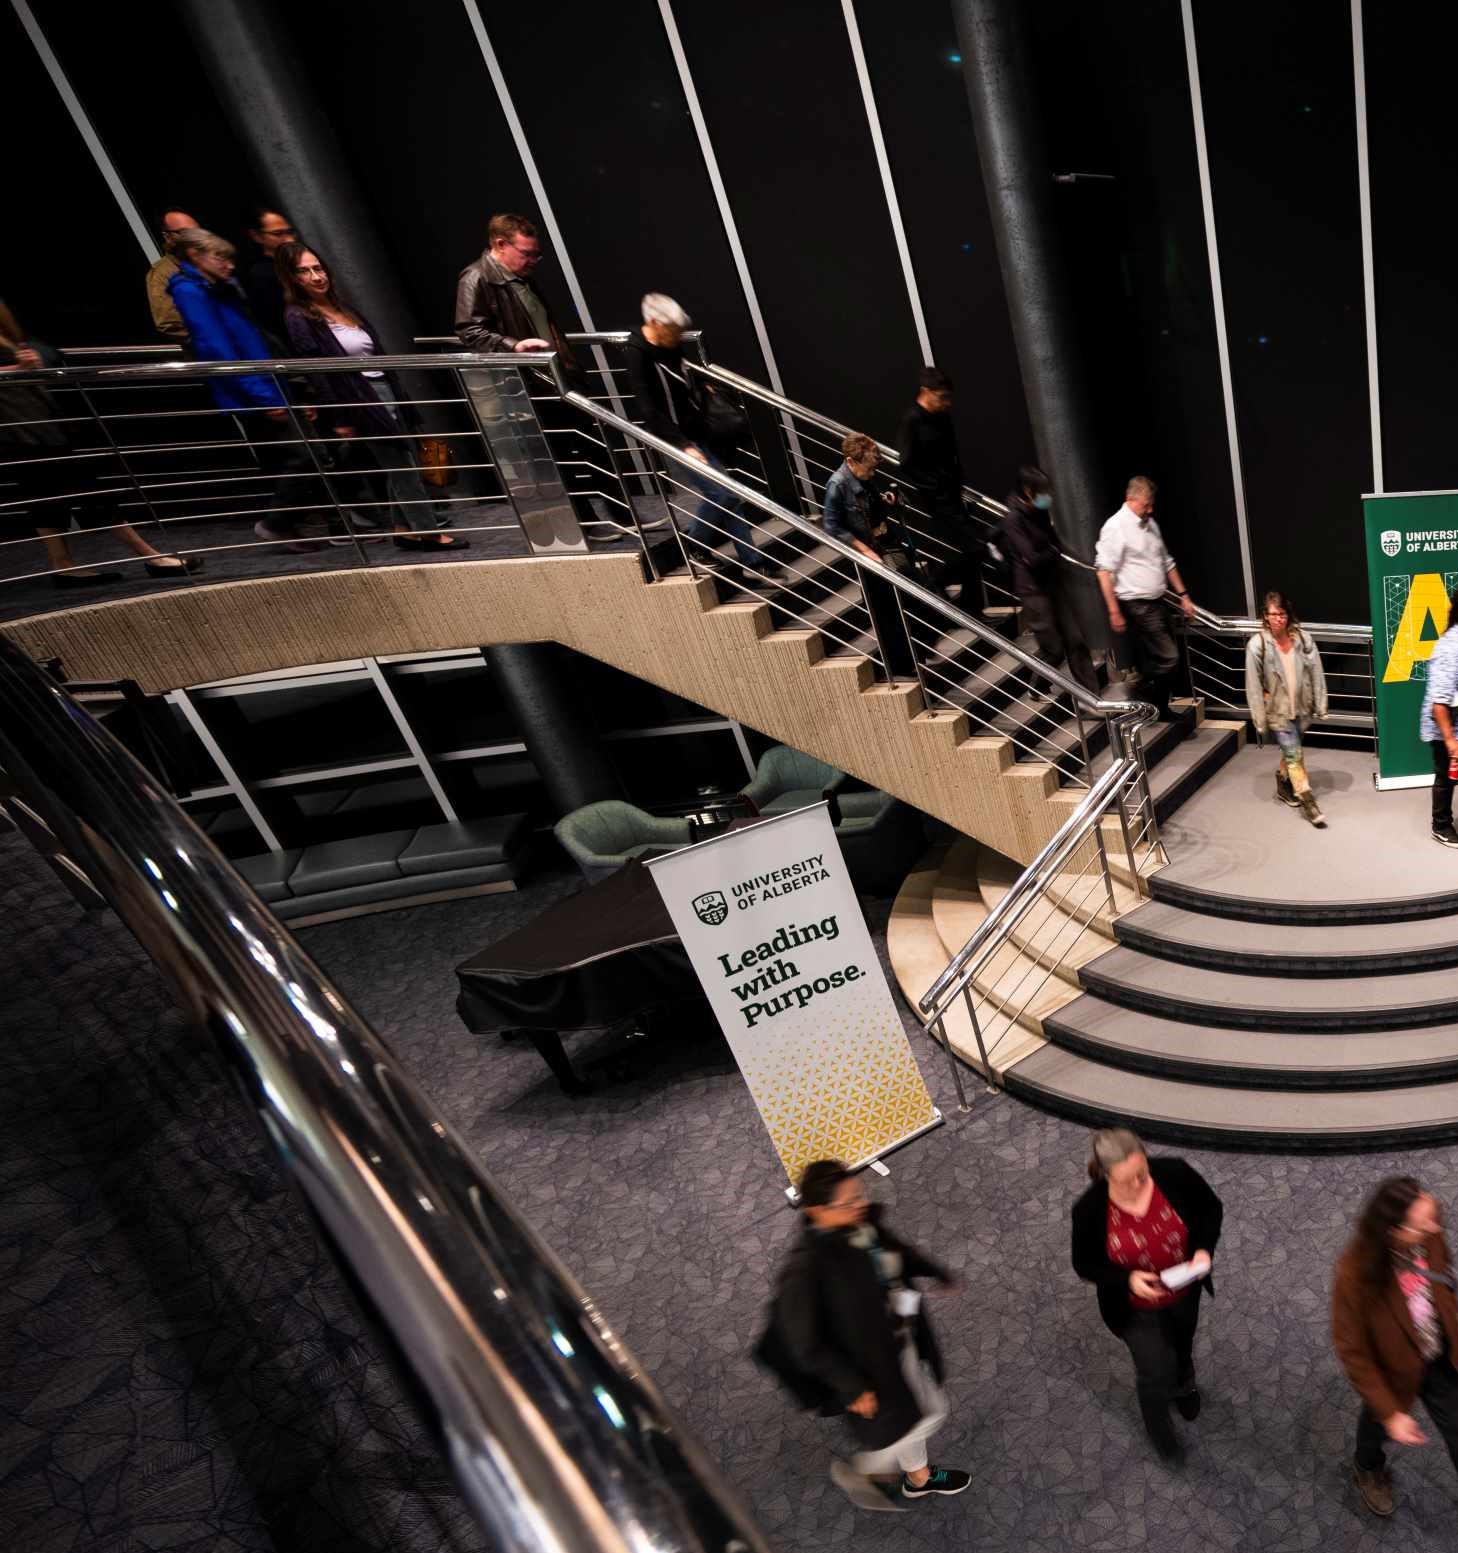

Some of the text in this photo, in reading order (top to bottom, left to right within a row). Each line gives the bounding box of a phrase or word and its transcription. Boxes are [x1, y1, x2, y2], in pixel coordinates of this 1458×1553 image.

[1407, 543, 1421, 553] OF
[732, 854, 825, 897] UNIVERSITY
[738, 869, 831, 911] OF ALBERTA
[718, 915, 840, 978] Leading
[731, 959, 801, 1002] with
[740, 965, 866, 1028] Purpose.
